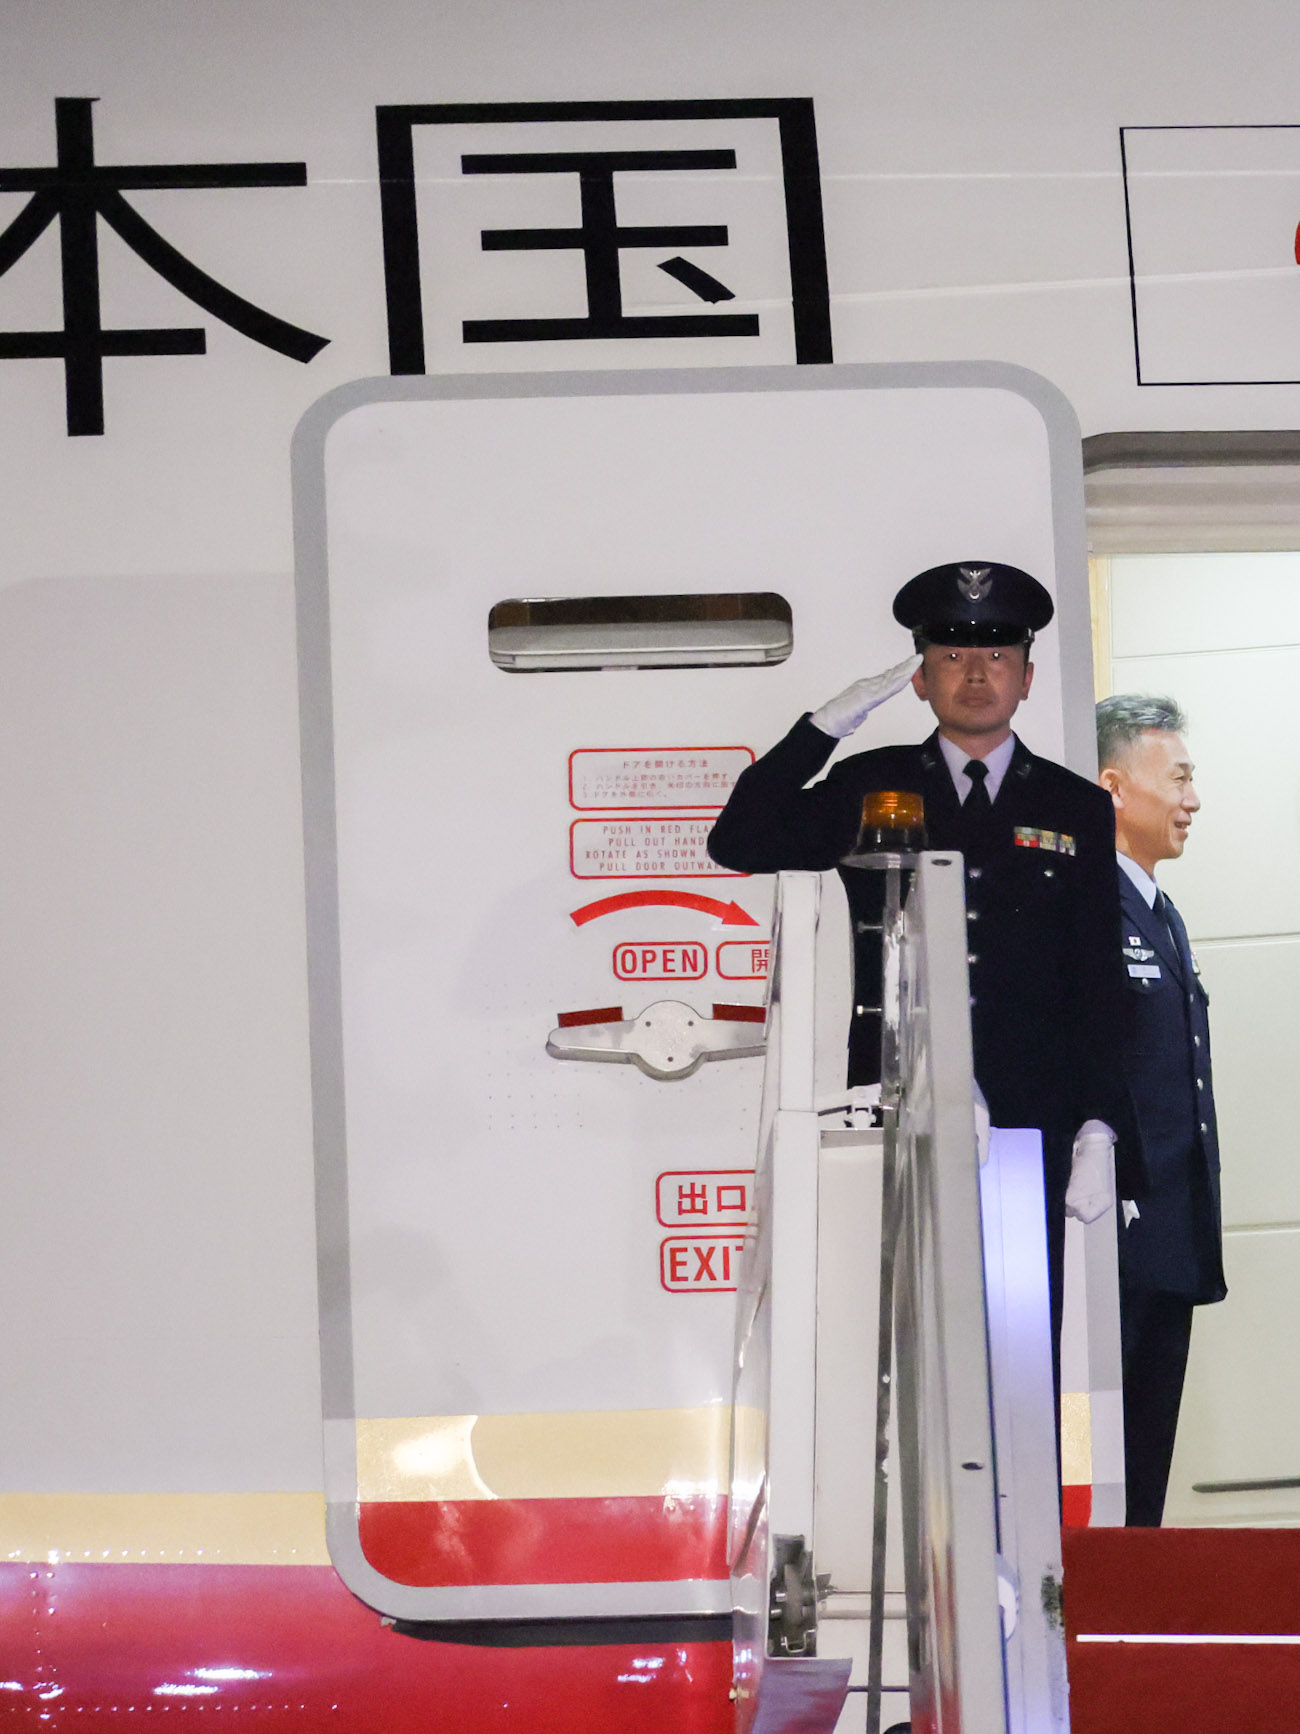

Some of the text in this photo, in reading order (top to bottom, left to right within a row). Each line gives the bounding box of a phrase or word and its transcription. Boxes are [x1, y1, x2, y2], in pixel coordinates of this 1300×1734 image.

[0, 96, 834, 436] 本国
[603, 824, 714, 835] PUSH IN RED FLA
[608, 836, 705, 847] PULL OUT HAND
[585, 850, 627, 860] ROTATE
[636, 849, 649, 859] AS
[657, 849, 696, 859] SHOWN
[599, 861, 726, 871] PULL DOOR OUTWAR
[620, 948, 698, 975] OPEN
[677, 1181, 747, 1216] 出口
